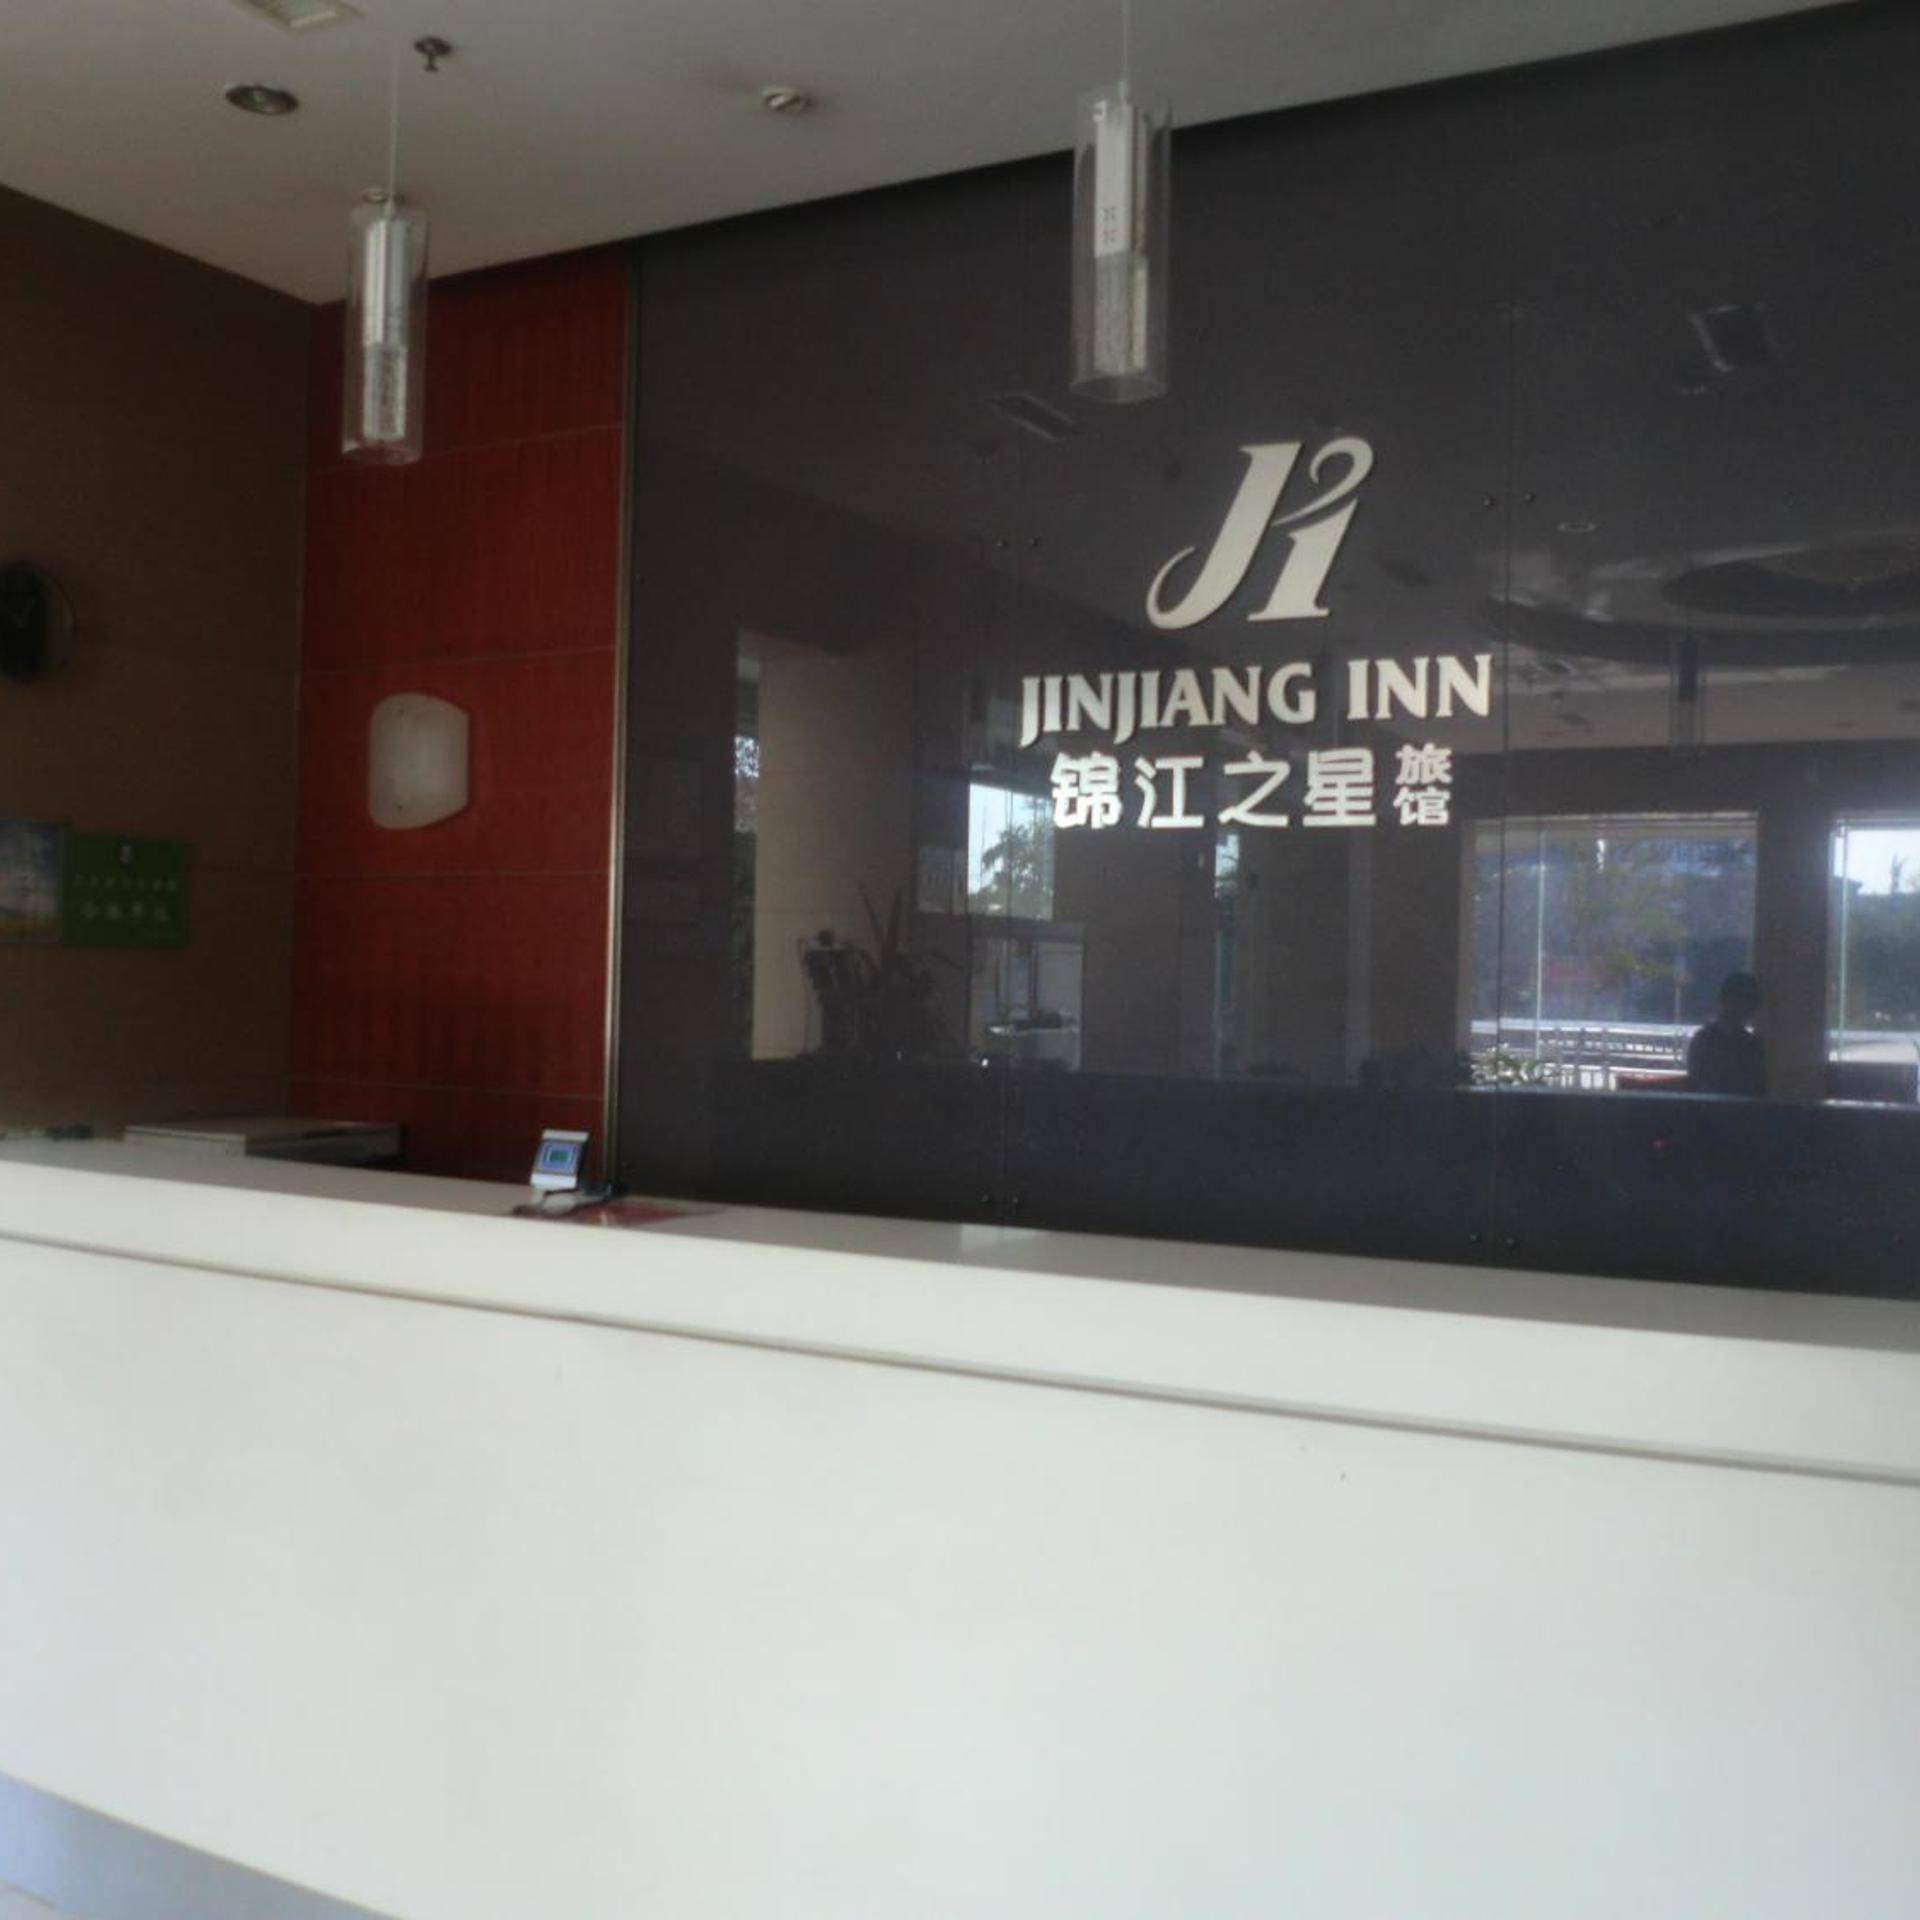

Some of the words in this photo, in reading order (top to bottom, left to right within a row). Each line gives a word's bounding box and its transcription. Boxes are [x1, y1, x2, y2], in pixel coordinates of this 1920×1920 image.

[1019, 662, 1317, 748] JINJIANG
[1347, 653, 1492, 720] INN
[1050, 747, 1377, 829] 锦江之星
